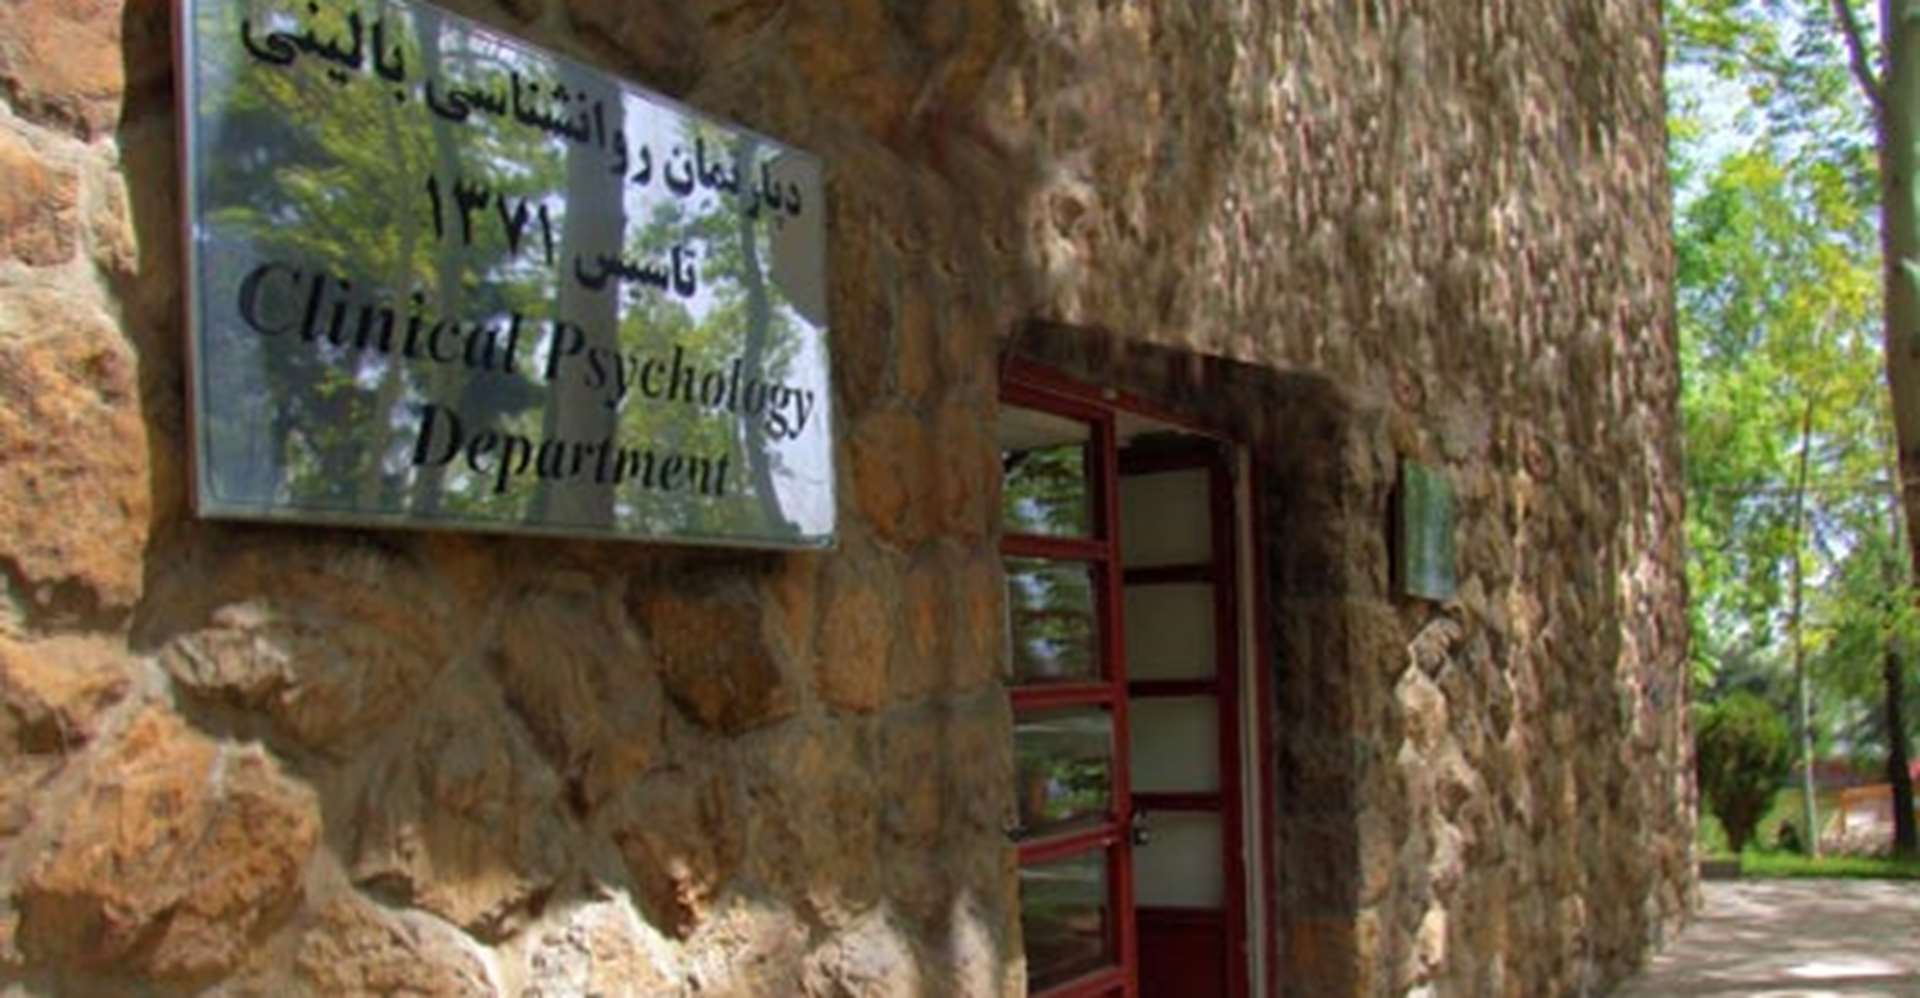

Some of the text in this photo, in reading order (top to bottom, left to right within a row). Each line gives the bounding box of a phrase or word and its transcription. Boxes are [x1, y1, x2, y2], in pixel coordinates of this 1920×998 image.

[242, 2, 405, 103] بالینی
[425, 72, 651, 186] روانشناسی
[427, 174, 696, 298] تاسیس ۱۳۷۱
[239, 262, 815, 442] Clinical Psychology
[412, 403, 730, 496] Department
